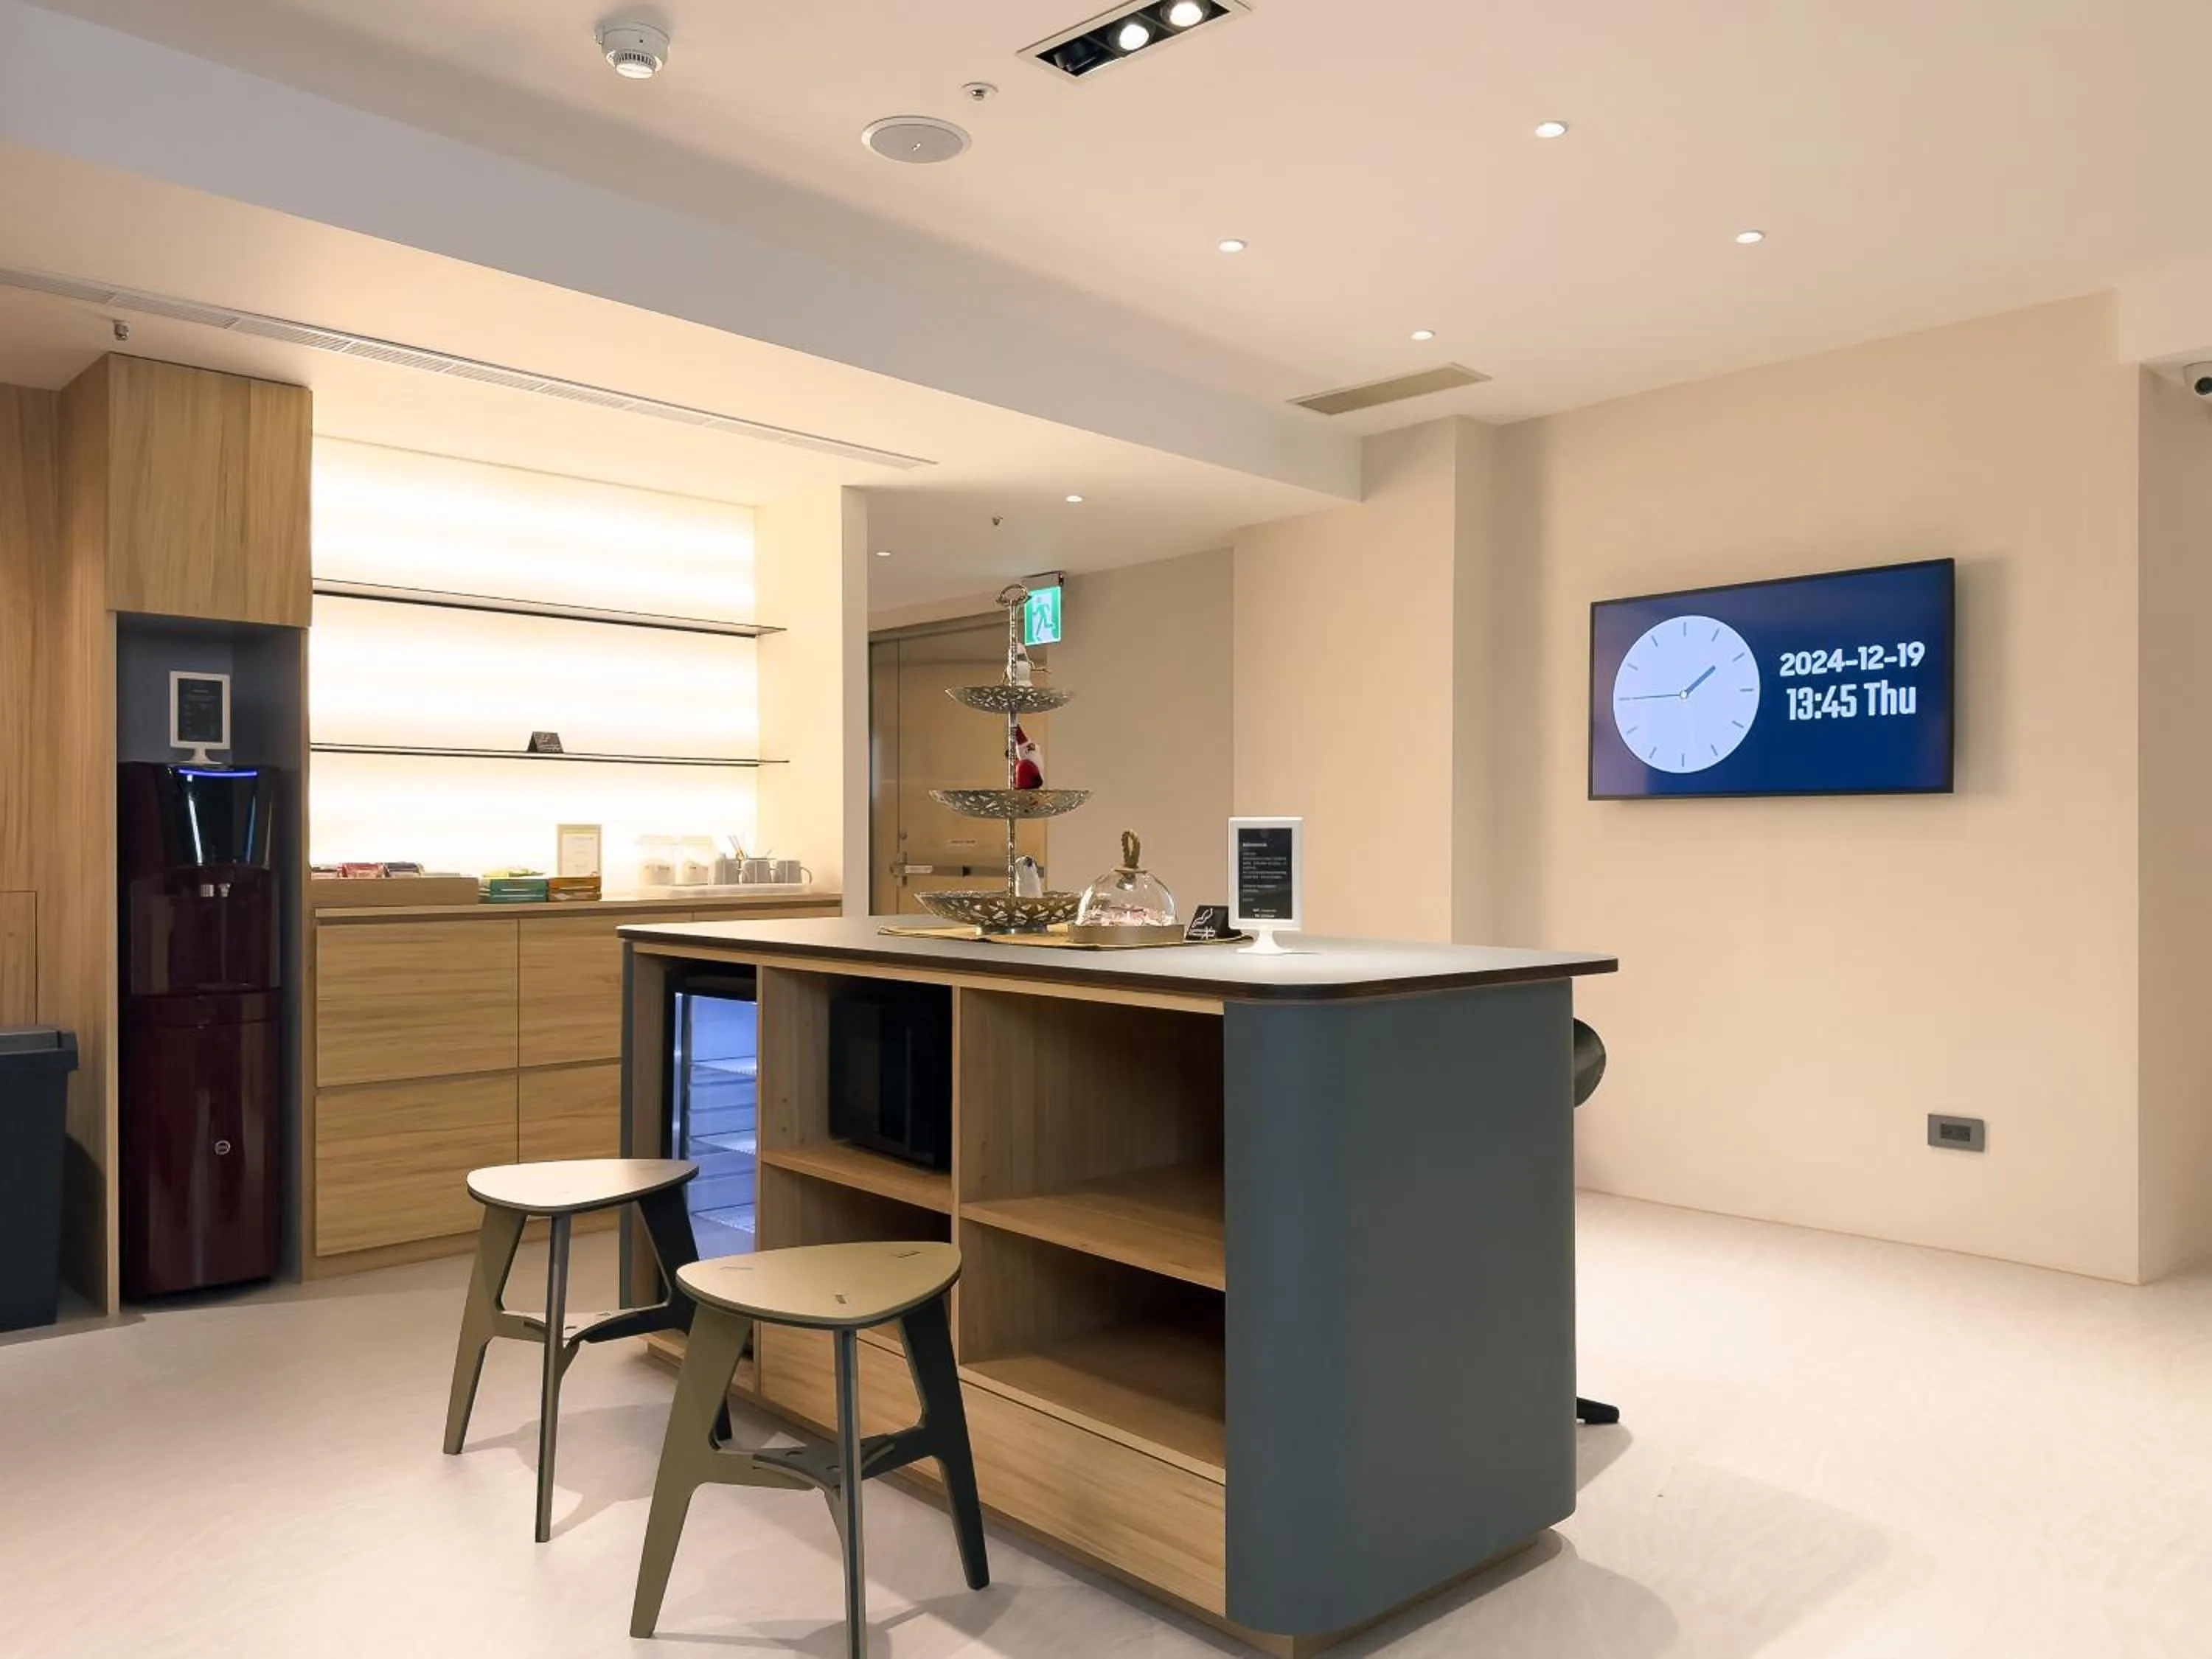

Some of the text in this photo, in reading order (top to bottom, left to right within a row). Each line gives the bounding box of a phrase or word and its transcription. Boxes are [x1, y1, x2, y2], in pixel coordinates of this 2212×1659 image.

[1779, 641, 1925, 676] 2024-12-19
[1787, 680, 1916, 720] 13:45 Thu
